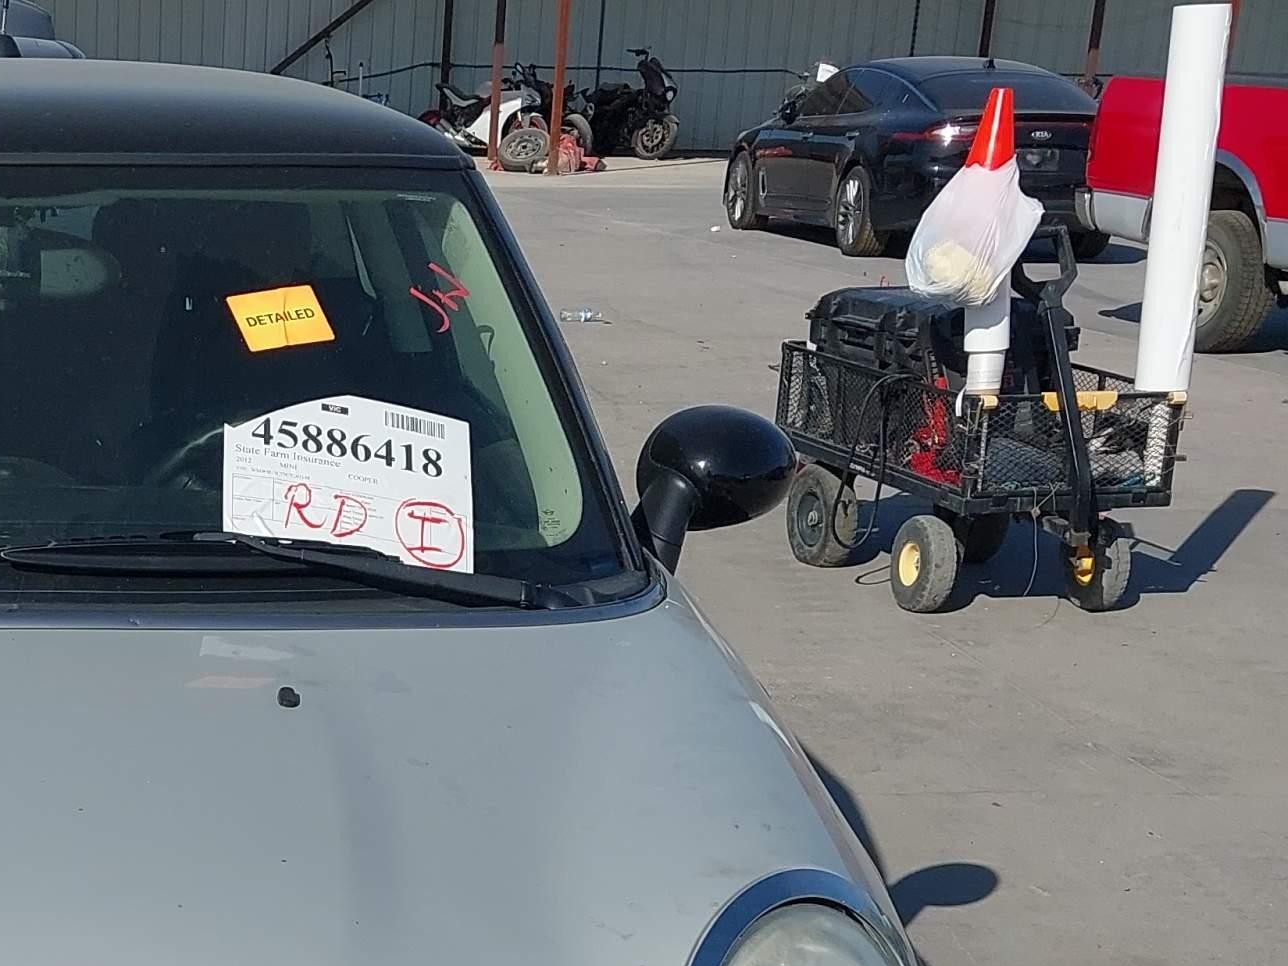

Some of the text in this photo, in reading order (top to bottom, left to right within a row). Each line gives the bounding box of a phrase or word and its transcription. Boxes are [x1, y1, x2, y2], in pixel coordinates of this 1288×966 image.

[245, 307, 316, 328] DETAILED
[235, 443, 342, 468] State Farm Insurance
[251, 416, 444, 479] 45886418
